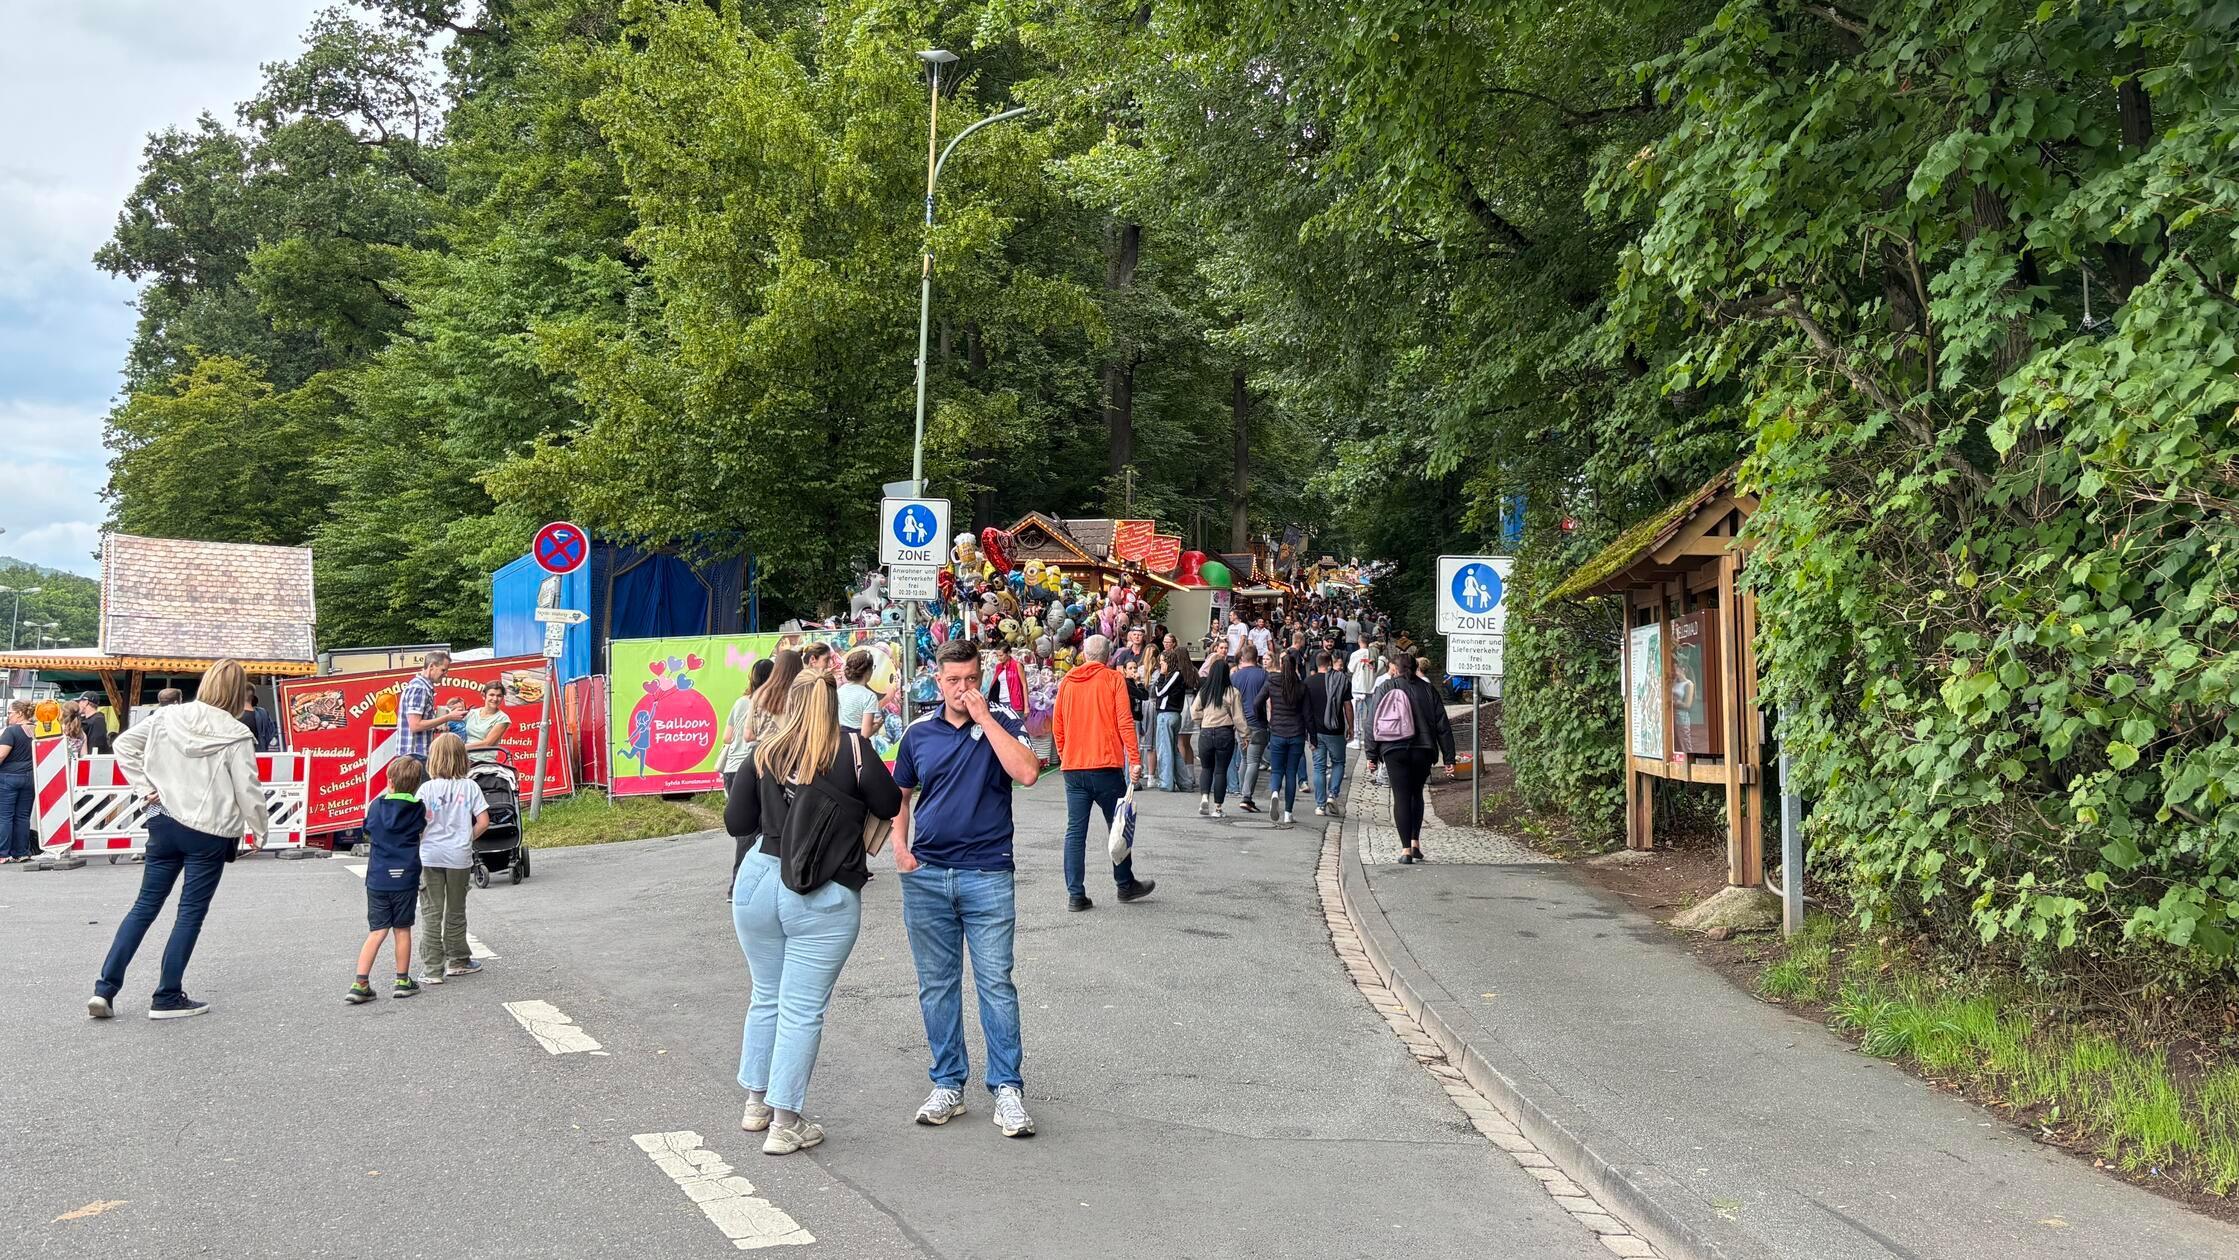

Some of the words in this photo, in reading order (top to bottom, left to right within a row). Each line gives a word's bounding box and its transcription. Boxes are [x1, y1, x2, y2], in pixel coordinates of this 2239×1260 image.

[898, 550, 931, 561] ZONE
[892, 567, 922, 575] Anwohner
[1457, 617, 1496, 630] ZONE
[1451, 637, 1486, 646] Anwohner
[1452, 646, 1500, 654] Lieferverkehr
[654, 717, 710, 731] Balloon
[655, 731, 709, 747] Factory
[513, 748, 554, 761] Schniel
[308, 803, 326, 815] 1/2
[327, 798, 354, 810] Meter
